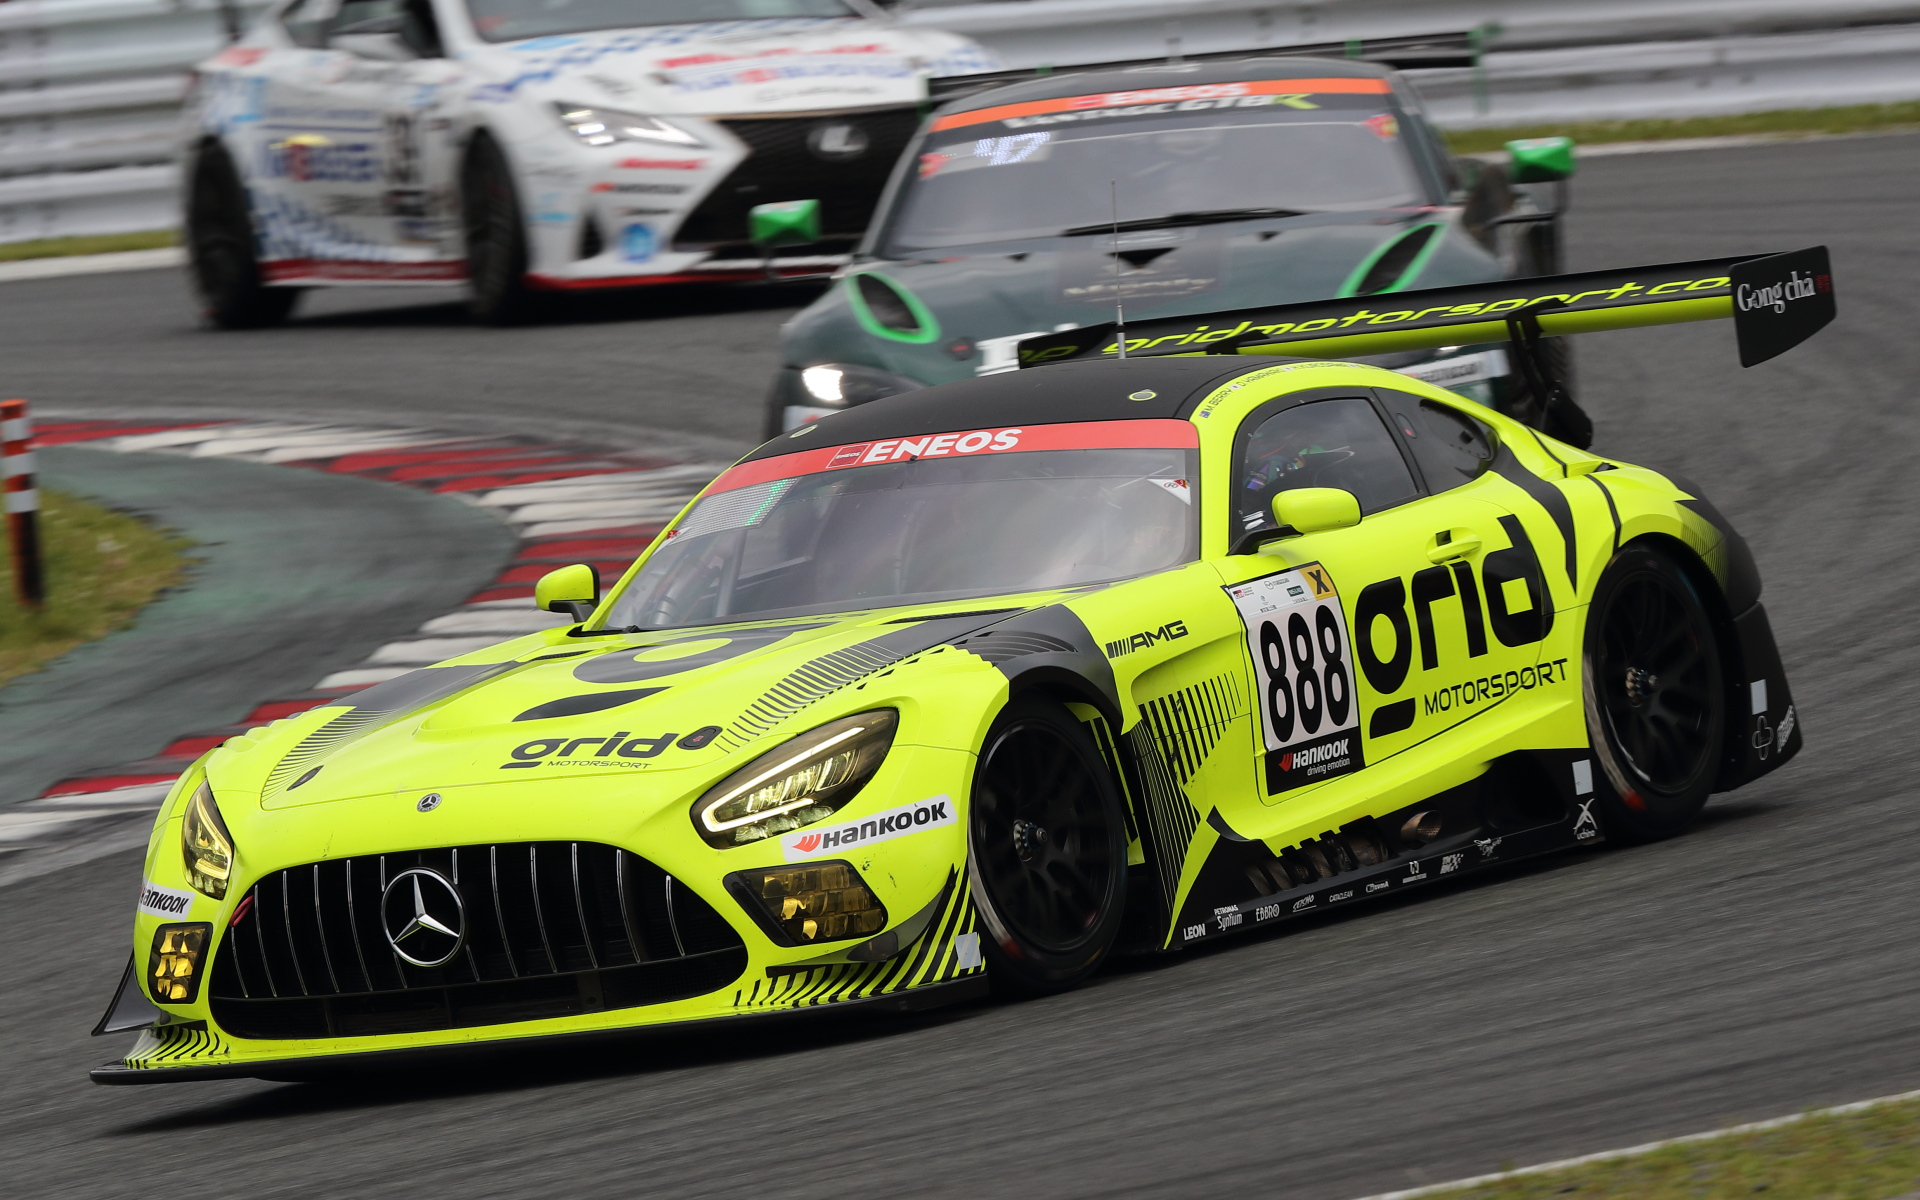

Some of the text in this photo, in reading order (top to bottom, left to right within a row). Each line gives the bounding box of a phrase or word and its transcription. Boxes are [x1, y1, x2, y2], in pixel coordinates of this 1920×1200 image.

[1105, 82, 1250, 107] ENEOS
[1737, 282, 1786, 314] Gong
[862, 428, 1023, 464] ENEOS
[1307, 569, 1330, 595] X
[1130, 619, 1189, 653] AMG
[1354, 513, 1555, 740] grid
[1259, 604, 1351, 743] 888
[1424, 657, 1568, 716] MOTORSPORT
[500, 731, 680, 770] grid
[547, 760, 652, 770] MOTORSPORT
[1307, 757, 1351, 776] driving emotion
[1213, 904, 1239, 916] PETRONAS
[1183, 923, 1206, 941] LEON
